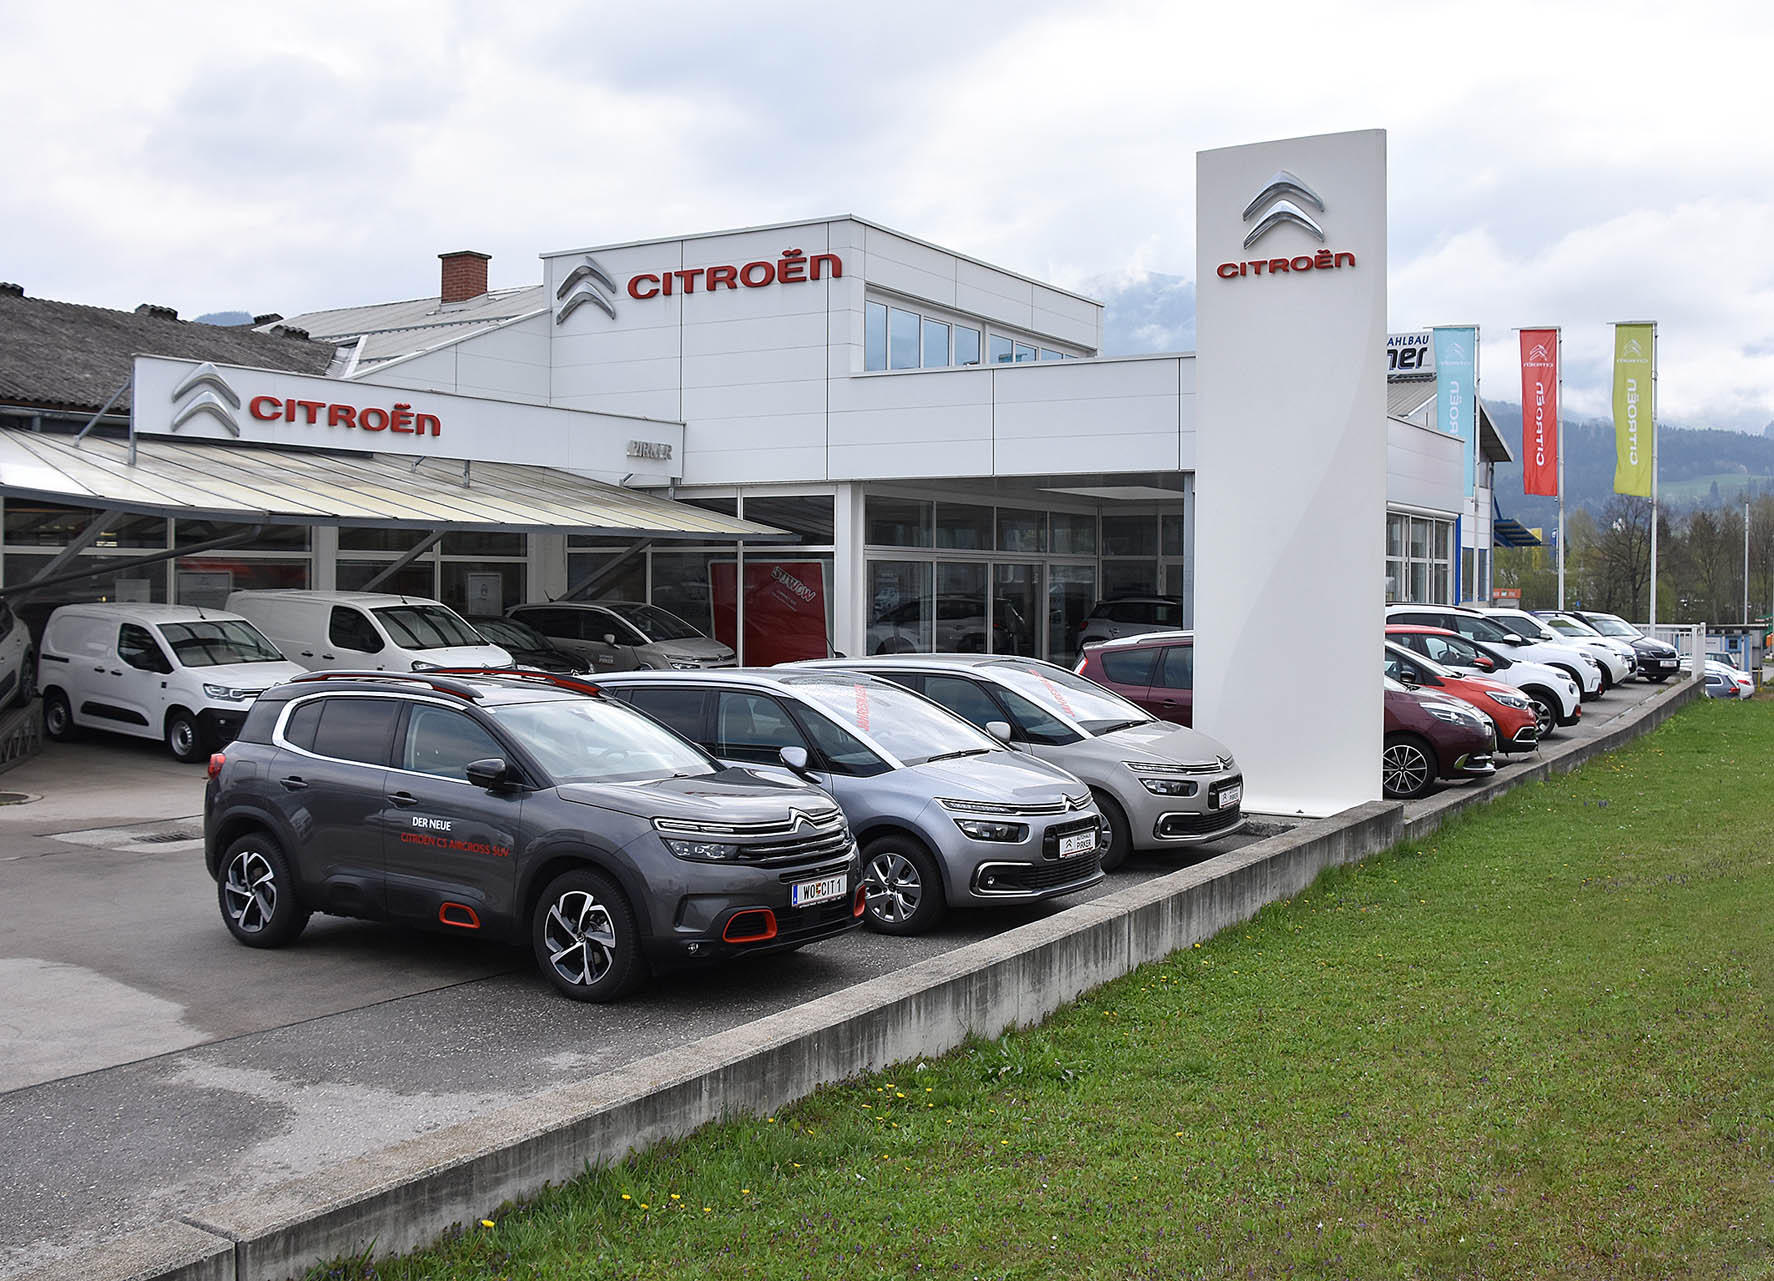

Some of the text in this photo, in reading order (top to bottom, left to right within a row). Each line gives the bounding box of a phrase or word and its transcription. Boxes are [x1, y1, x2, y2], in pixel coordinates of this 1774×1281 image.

[627, 248, 843, 300] CITROËN
[1216, 249, 1356, 279] CITROËN
[1387, 335, 1429, 346] AHLBAU
[1387, 347, 1428, 371] ner
[249, 395, 442, 437] CITROËN
[412, 816, 452, 831] DER NEUE
[492, 845, 510, 857] SUV
[821, 880, 834, 896] CIT
